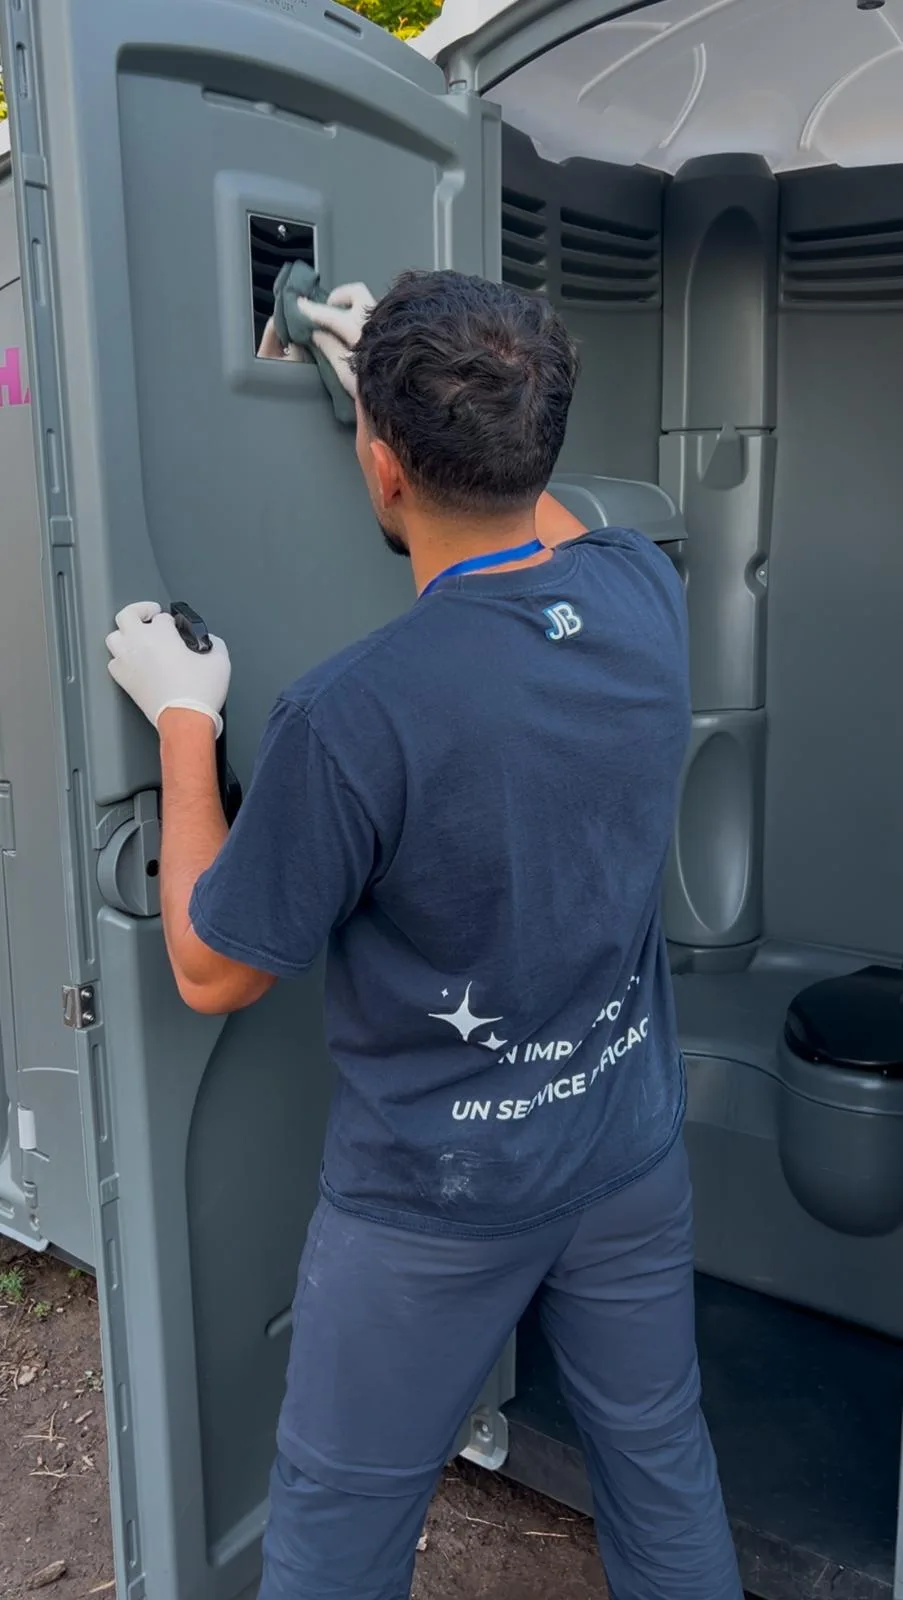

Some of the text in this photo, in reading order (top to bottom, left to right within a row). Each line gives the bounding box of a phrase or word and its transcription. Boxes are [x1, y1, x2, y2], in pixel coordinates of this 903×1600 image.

[543, 601, 583, 640] JB
[498, 1040, 582, 1064] N IMP
[452, 1100, 491, 1120] UN
